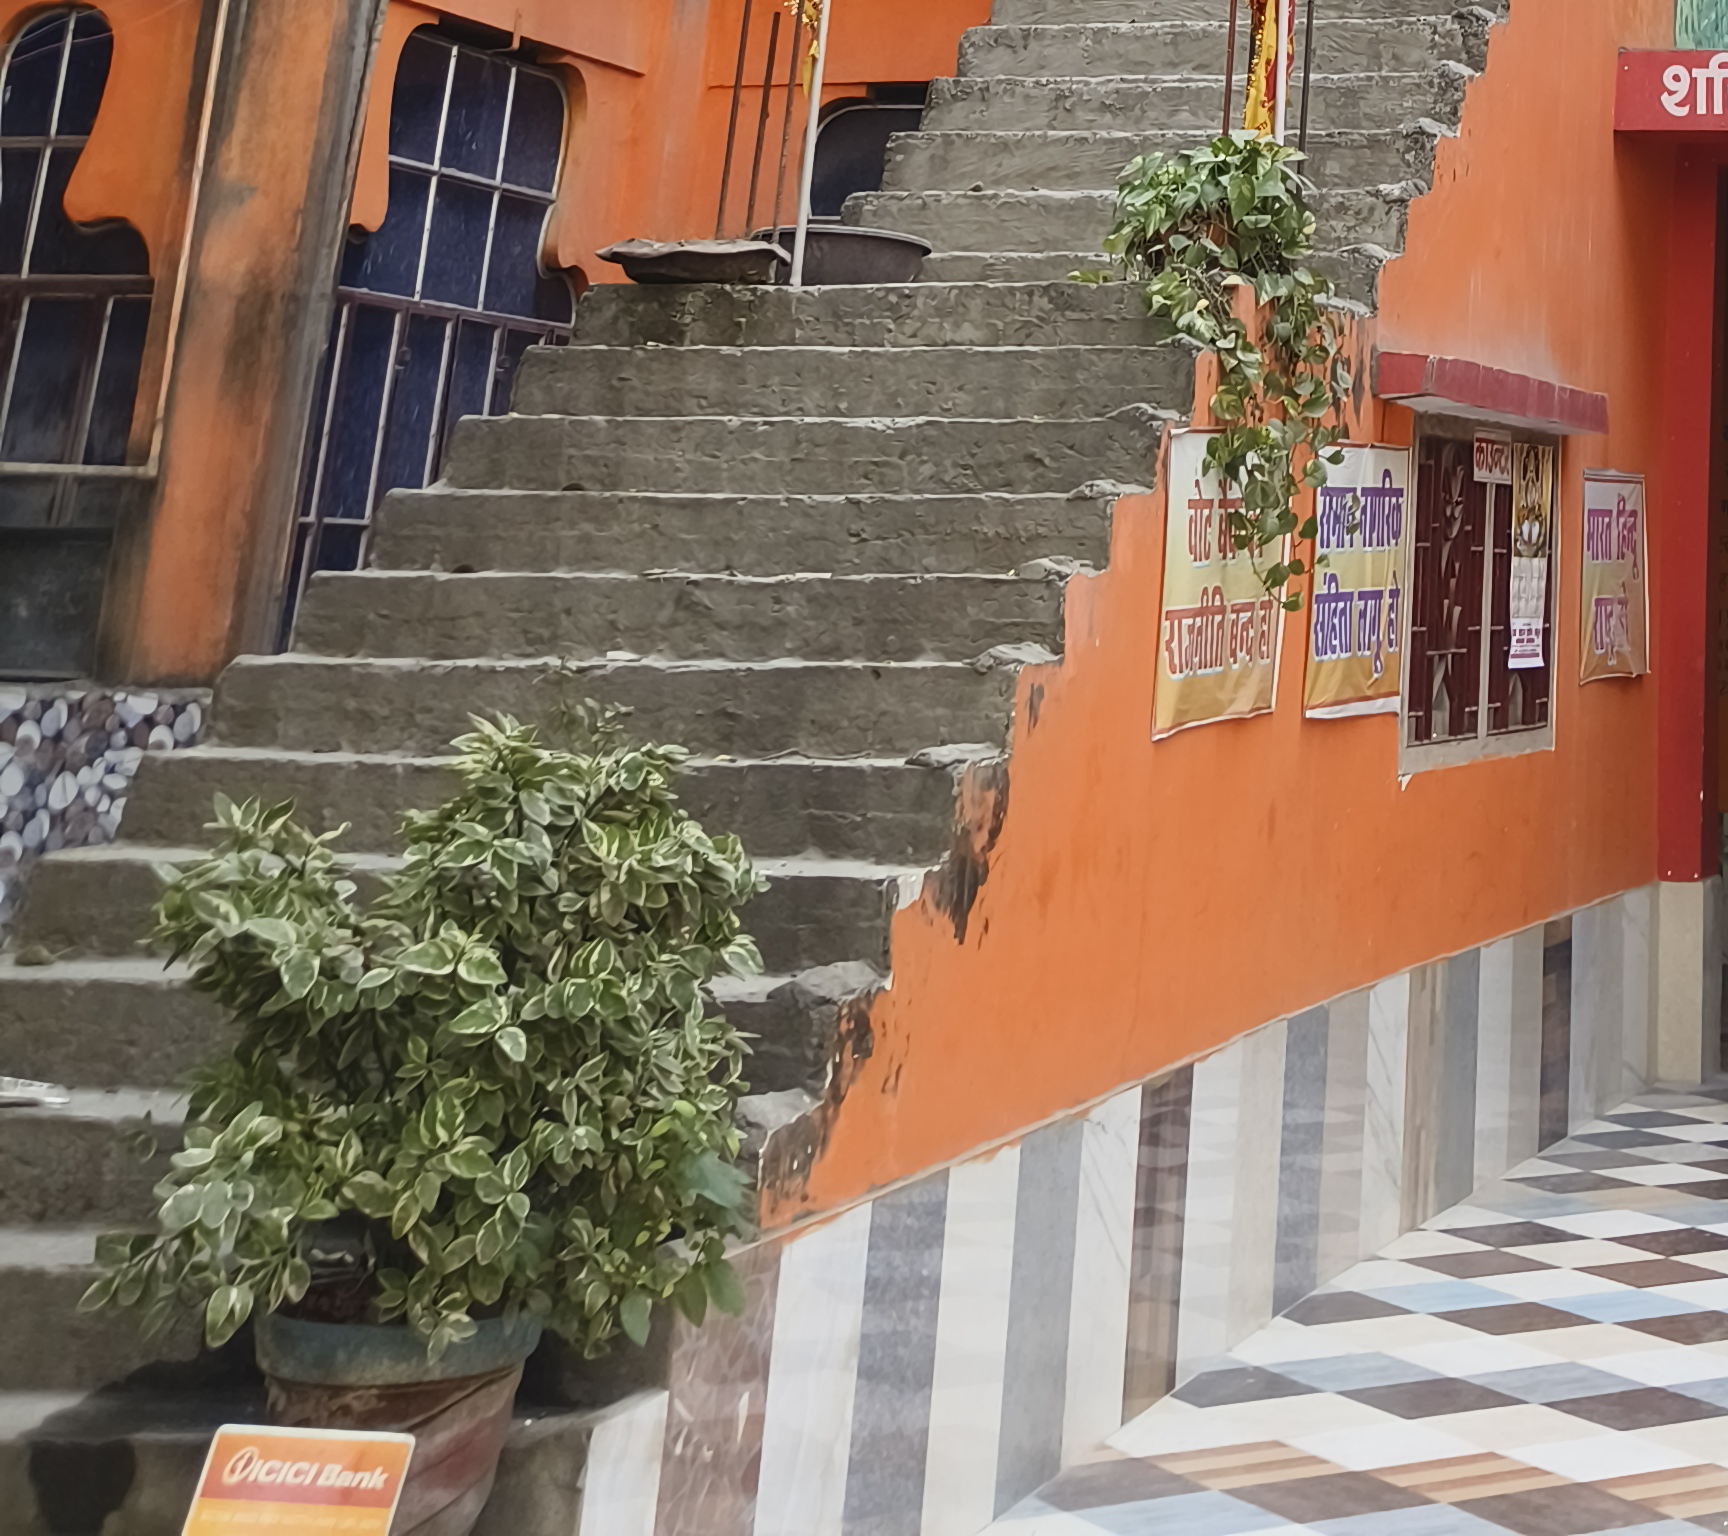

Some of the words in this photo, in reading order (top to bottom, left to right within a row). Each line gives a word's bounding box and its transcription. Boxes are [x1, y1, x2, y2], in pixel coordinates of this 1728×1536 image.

[1188, 479, 1214, 562] वोट
[1359, 468, 1404, 548] नागरिक
[1587, 508, 1613, 562] भारत
[1165, 585, 1226, 676] राजनीति
[1258, 595, 1273, 661] हो
[1314, 571, 1354, 658] संहिता
[1357, 589, 1384, 675] लागू
[1387, 570, 1401, 652] हो
[249, 1458, 317, 1486] ICICI
[316, 1463, 390, 1491] Bank
